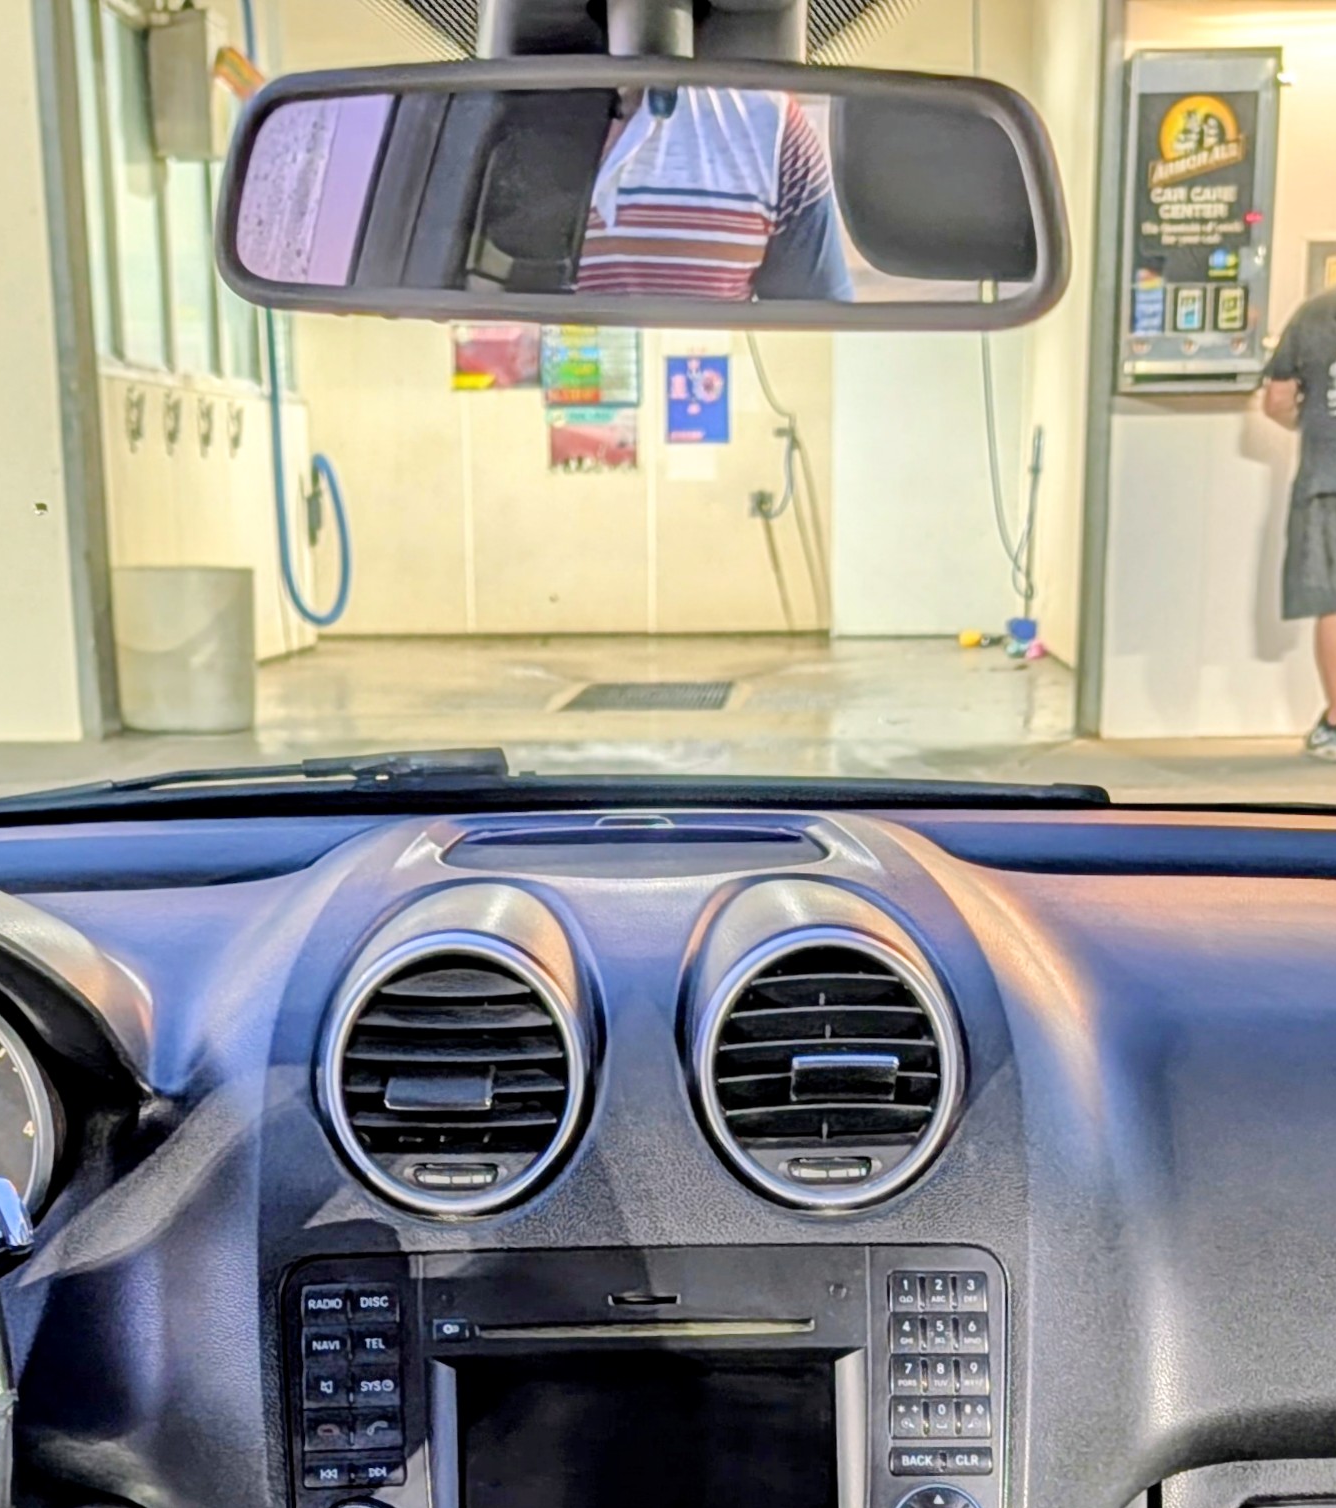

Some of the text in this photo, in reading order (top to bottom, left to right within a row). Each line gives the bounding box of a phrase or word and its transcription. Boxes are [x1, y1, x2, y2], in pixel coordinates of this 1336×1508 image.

[1150, 185, 1237, 203] CAR CARE
[1159, 203, 1229, 220] CENTER
[23, 1120, 36, 1138] 4
[902, 1279, 910, 1292] 1
[935, 1279, 943, 1291] 2
[967, 1279, 975, 1291] 3
[308, 1297, 343, 1310] RADIO
[359, 1295, 390, 1309] DISC
[902, 1320, 911, 1332] 4
[936, 1320, 945, 1332] 5
[968, 1320, 977, 1332] 6
[312, 1340, 341, 1351] NAVI
[365, 1337, 386, 1350] TEL
[904, 1362, 913, 1374] 7
[936, 1363, 945, 1375] 8
[969, 1362, 978, 1374] 9
[360, 1380, 382, 1393] SYS
[937, 1404, 946, 1416] 0
[901, 1455, 933, 1466] BACK
[955, 1455, 979, 1466] CLR
